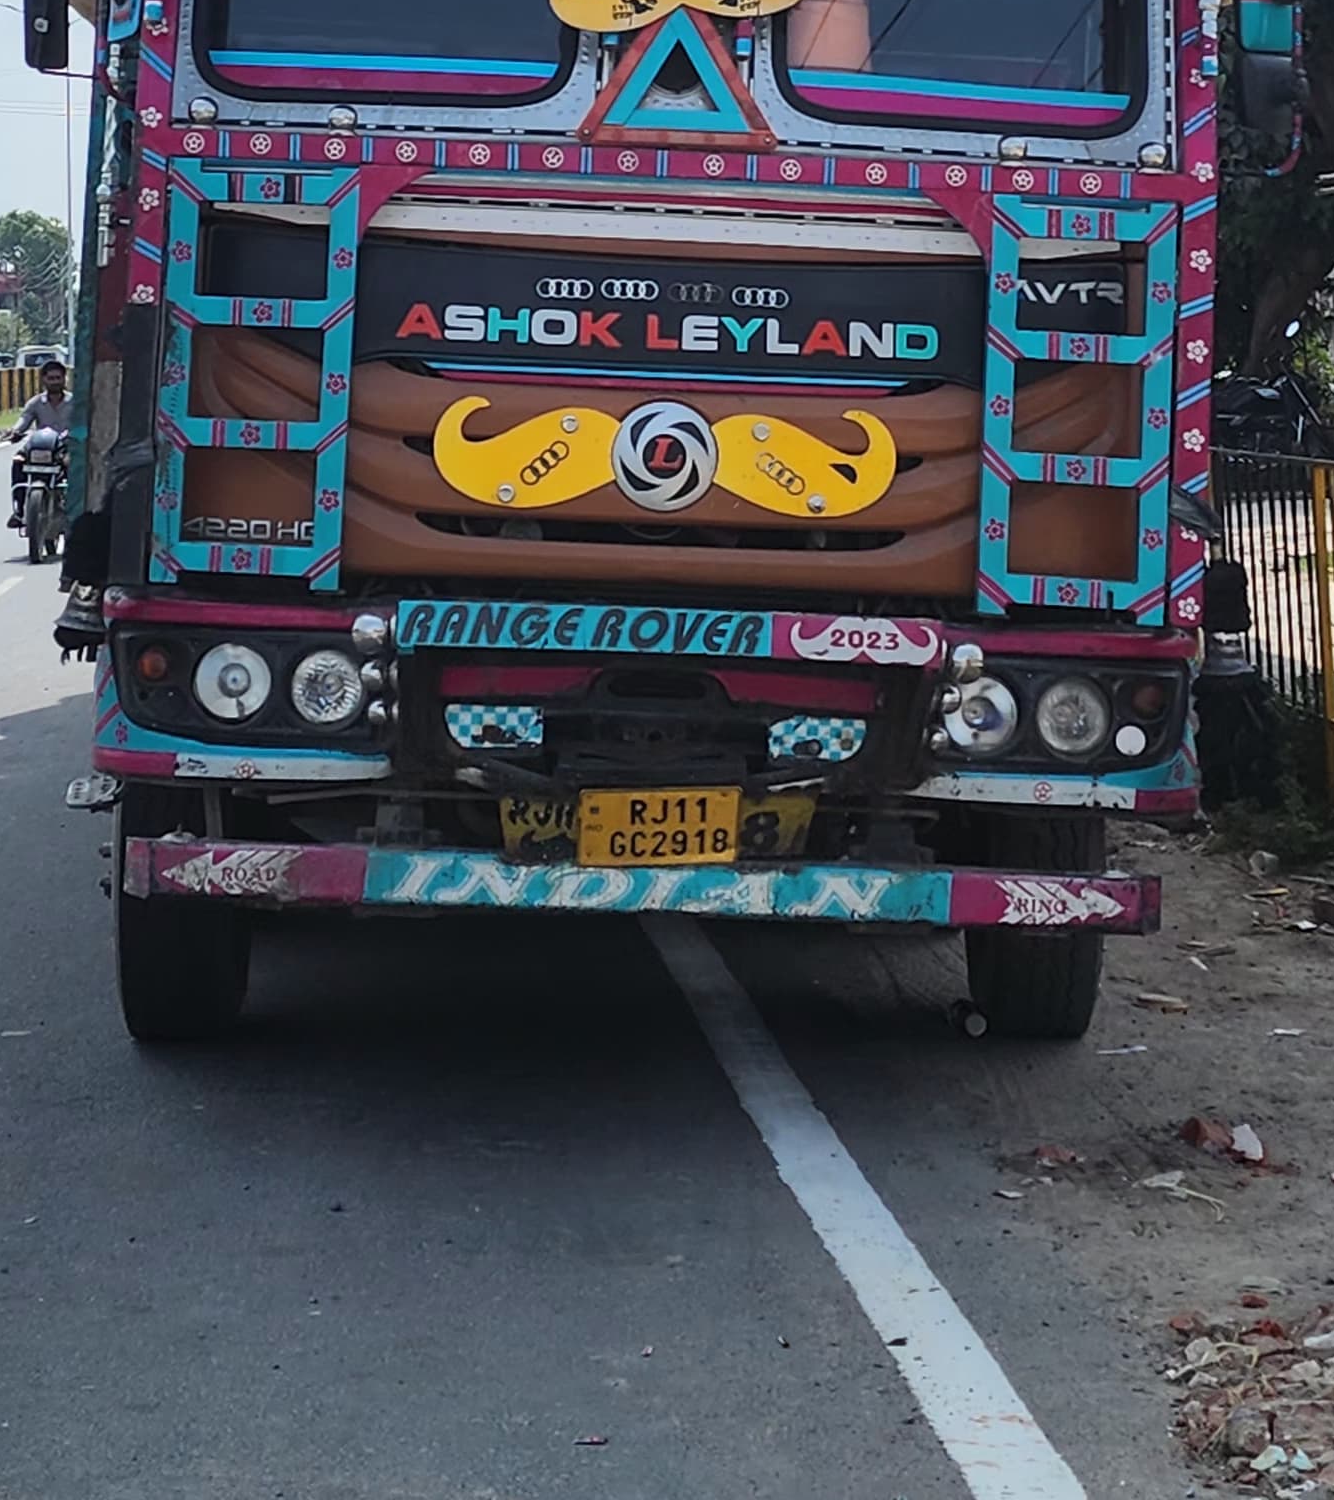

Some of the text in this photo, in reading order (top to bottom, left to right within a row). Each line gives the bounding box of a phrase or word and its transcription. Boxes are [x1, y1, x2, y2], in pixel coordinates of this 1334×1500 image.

[395, 303, 940, 361] ASHOK LEYLAND
[183, 516, 271, 540] 4220
[400, 604, 769, 656] RANGE ROVER
[829, 627, 901, 652] 2023
[629, 797, 708, 826] RJ11
[608, 827, 729, 859] GC2918
[221, 866, 278, 883] ROAD
[387, 854, 897, 919] INDIAN
